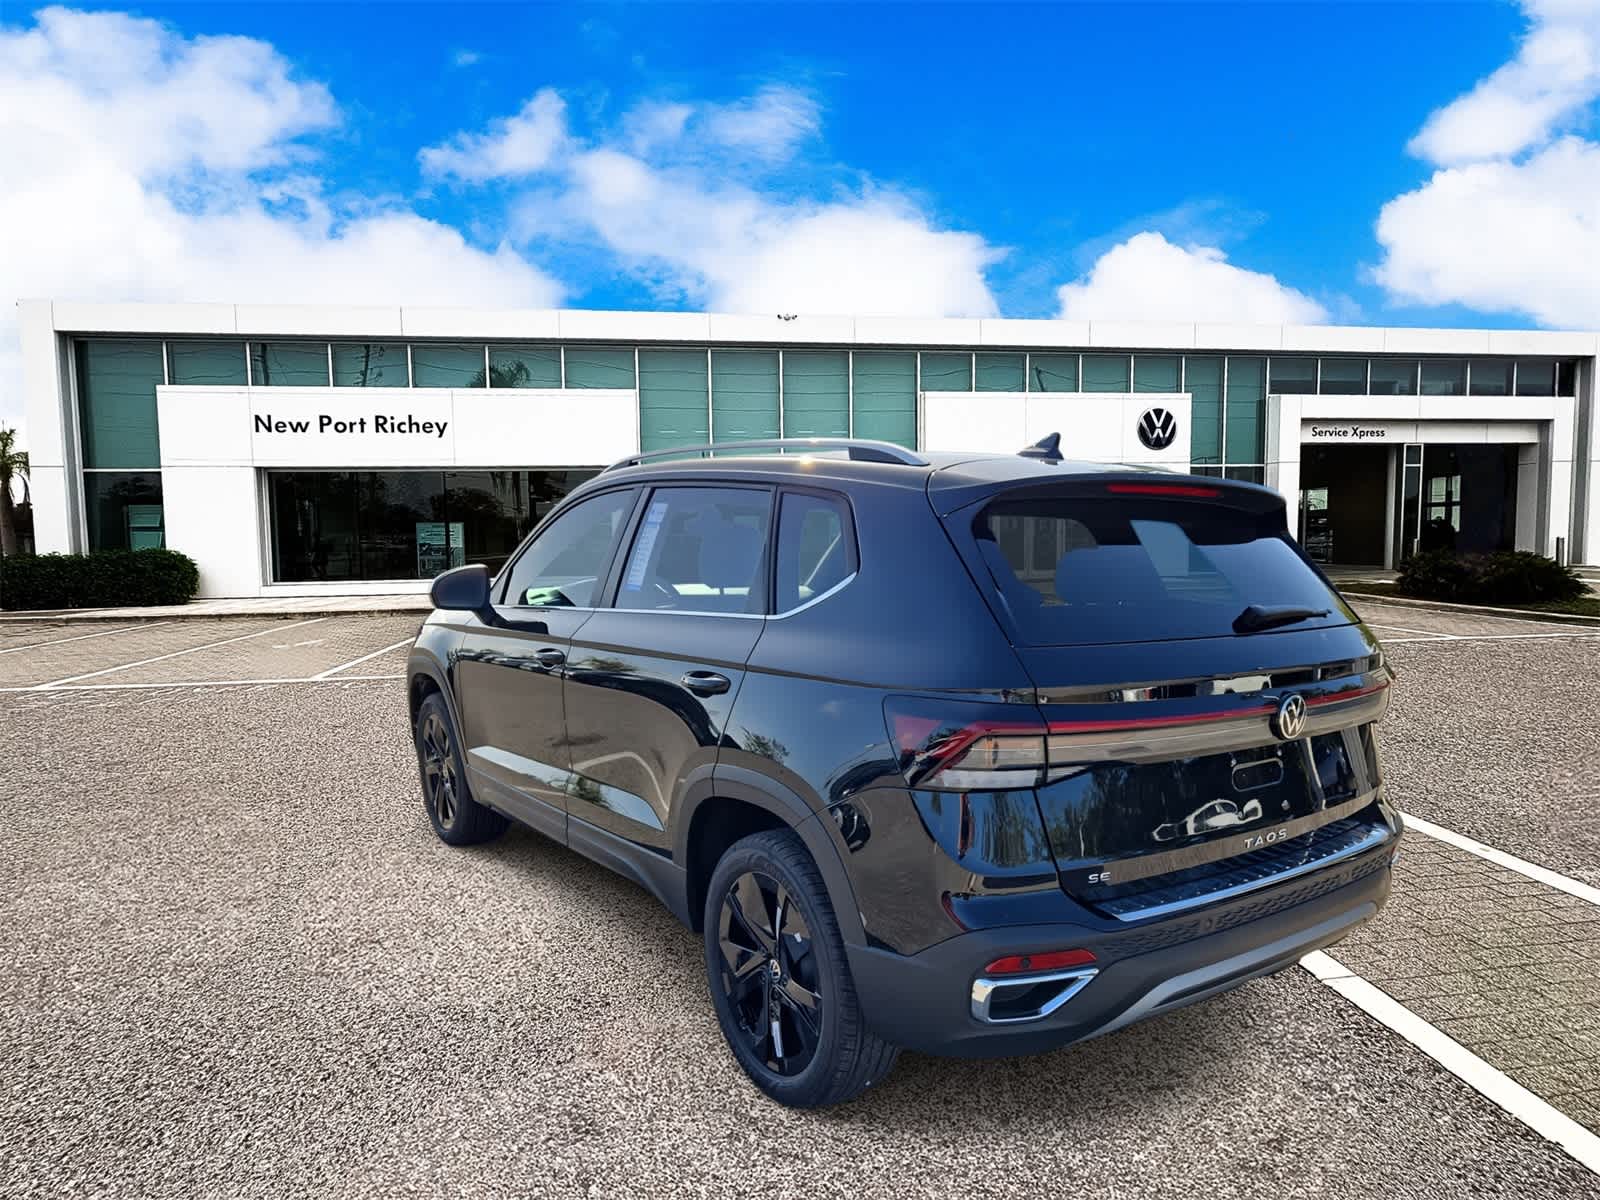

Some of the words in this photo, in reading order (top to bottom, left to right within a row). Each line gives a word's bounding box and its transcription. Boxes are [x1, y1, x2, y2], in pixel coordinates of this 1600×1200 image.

[254, 414, 310, 433] New
[318, 415, 367, 434] Port
[374, 414, 448, 438] Richey
[1138, 408, 1177, 449] VW
[1311, 426, 1348, 437] Service
[1351, 426, 1385, 439] Xpress
[1244, 828, 1287, 849] TAOS
[1088, 871, 1111, 884] SE
